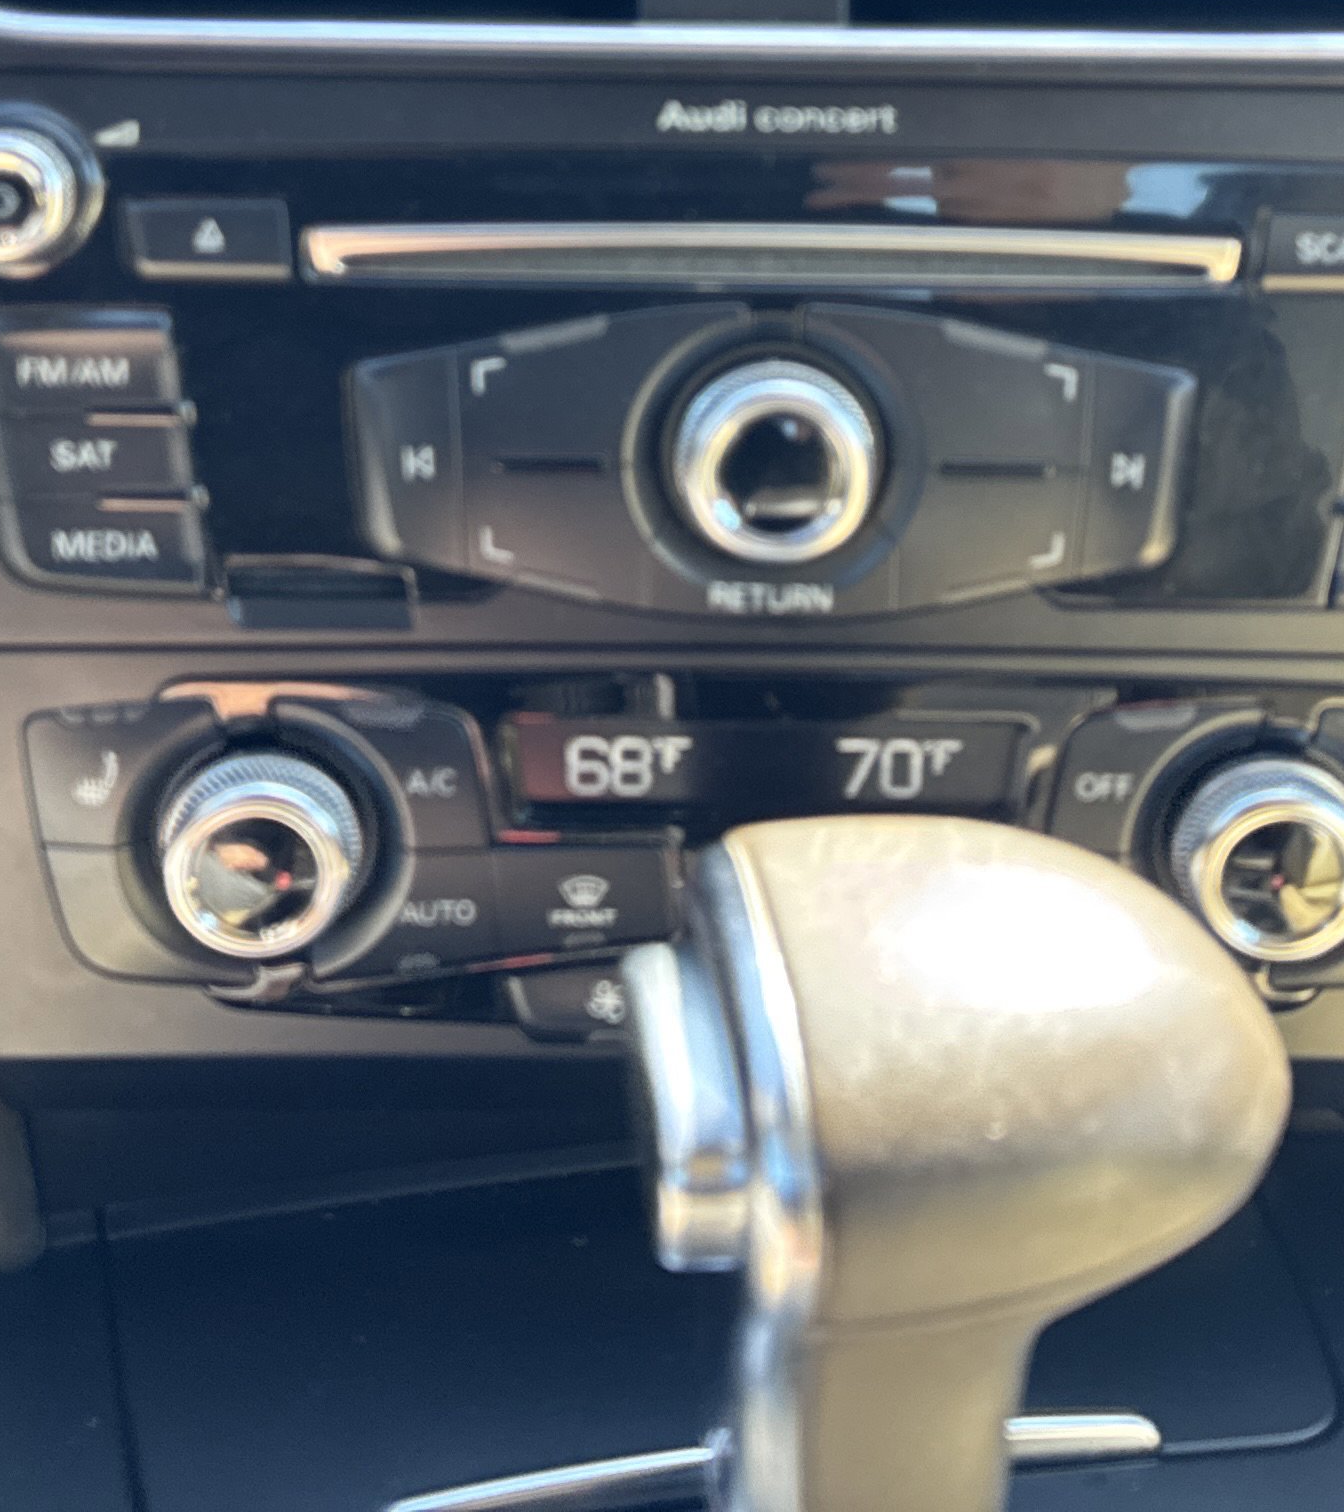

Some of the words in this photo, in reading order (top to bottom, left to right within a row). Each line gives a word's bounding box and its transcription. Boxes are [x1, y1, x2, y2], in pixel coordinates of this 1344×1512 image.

[657, 99, 748, 135] Audi
[756, 101, 899, 135] concert
[17, 357, 131, 388] FM/AM
[50, 440, 117, 471] SAT
[52, 529, 159, 561] MEDIA
[708, 584, 834, 615] RETURN
[406, 769, 458, 799] A/C
[1073, 773, 1135, 803] OFF
[399, 898, 477, 928] AUTO
